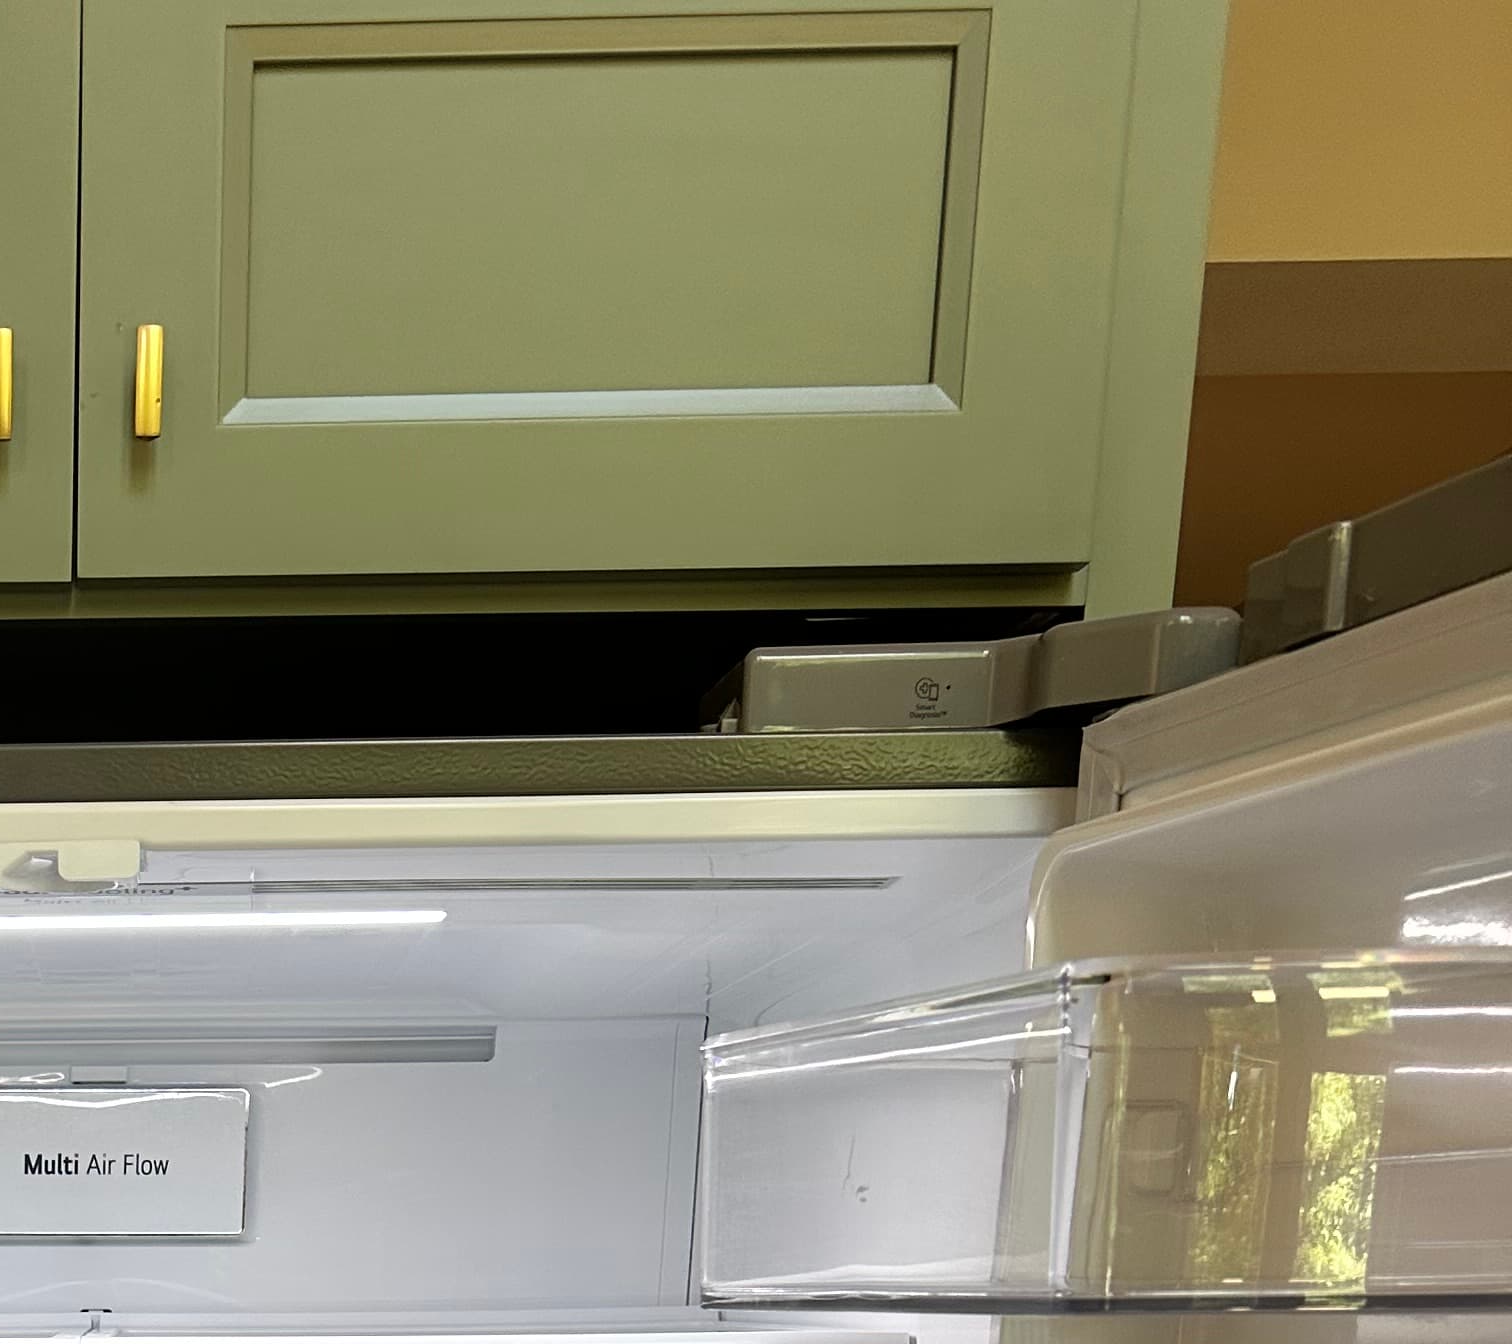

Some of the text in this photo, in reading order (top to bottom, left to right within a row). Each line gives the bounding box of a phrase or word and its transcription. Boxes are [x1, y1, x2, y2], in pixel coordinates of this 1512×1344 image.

[916, 703, 936, 711] Smart
[23, 1153, 170, 1176] Multi Air Flow
